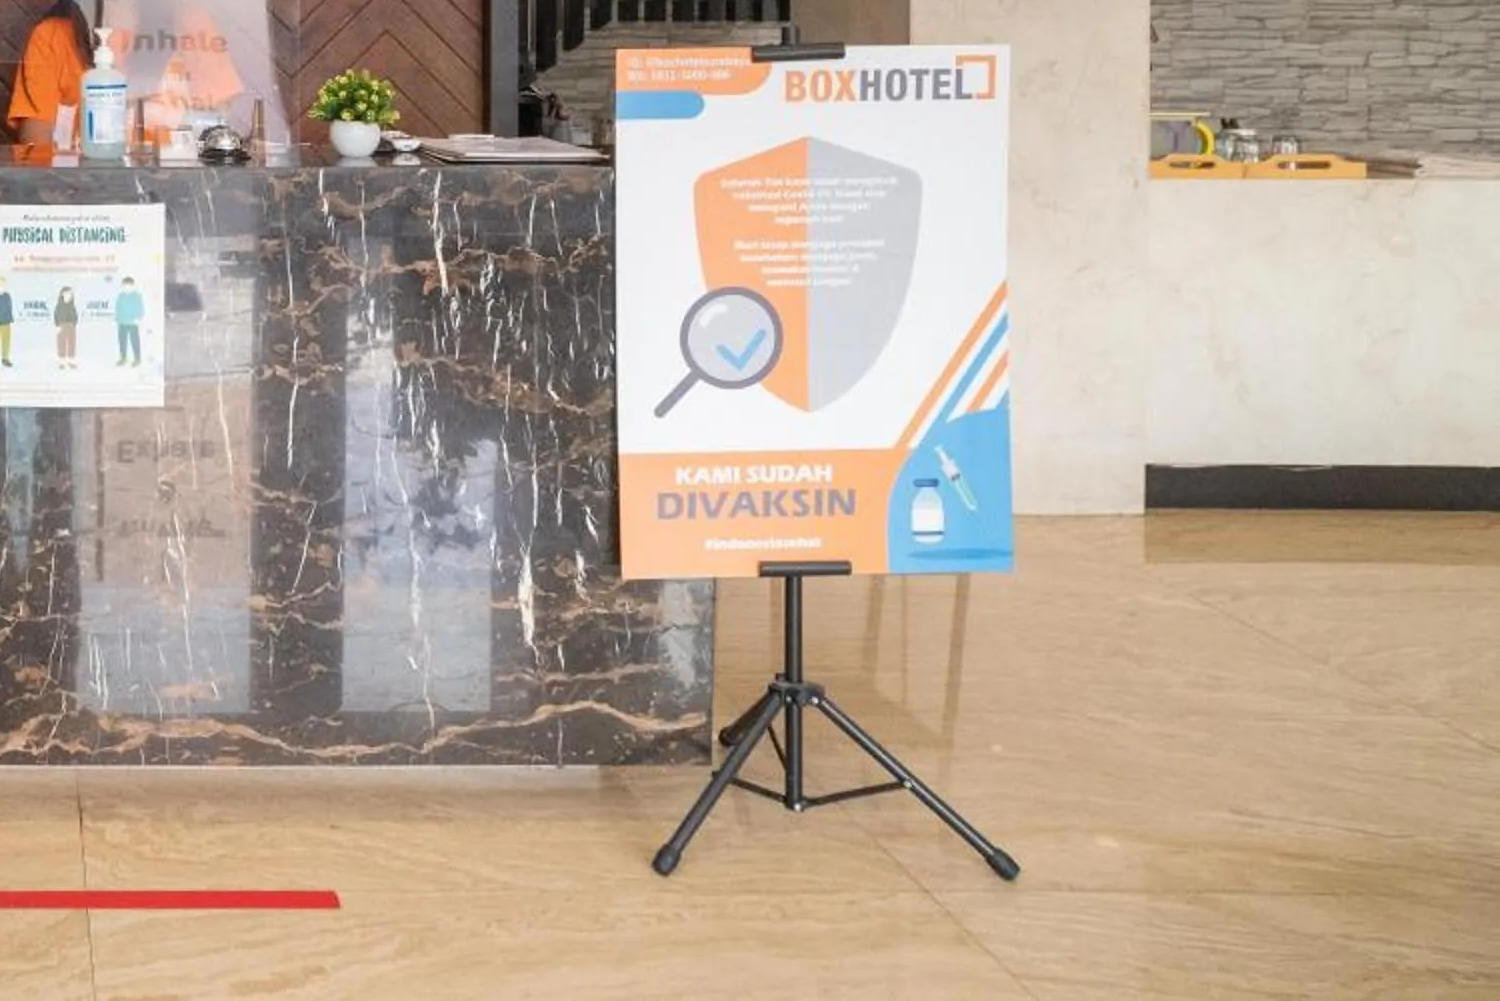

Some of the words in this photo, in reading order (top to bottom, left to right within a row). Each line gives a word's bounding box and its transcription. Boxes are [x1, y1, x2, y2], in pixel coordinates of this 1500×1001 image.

[785, 67, 974, 102] BOXHOTEL
[675, 465, 741, 486] KAMI
[747, 463, 833, 484] SUDAH
[656, 488, 857, 520] DIVAKSIN
